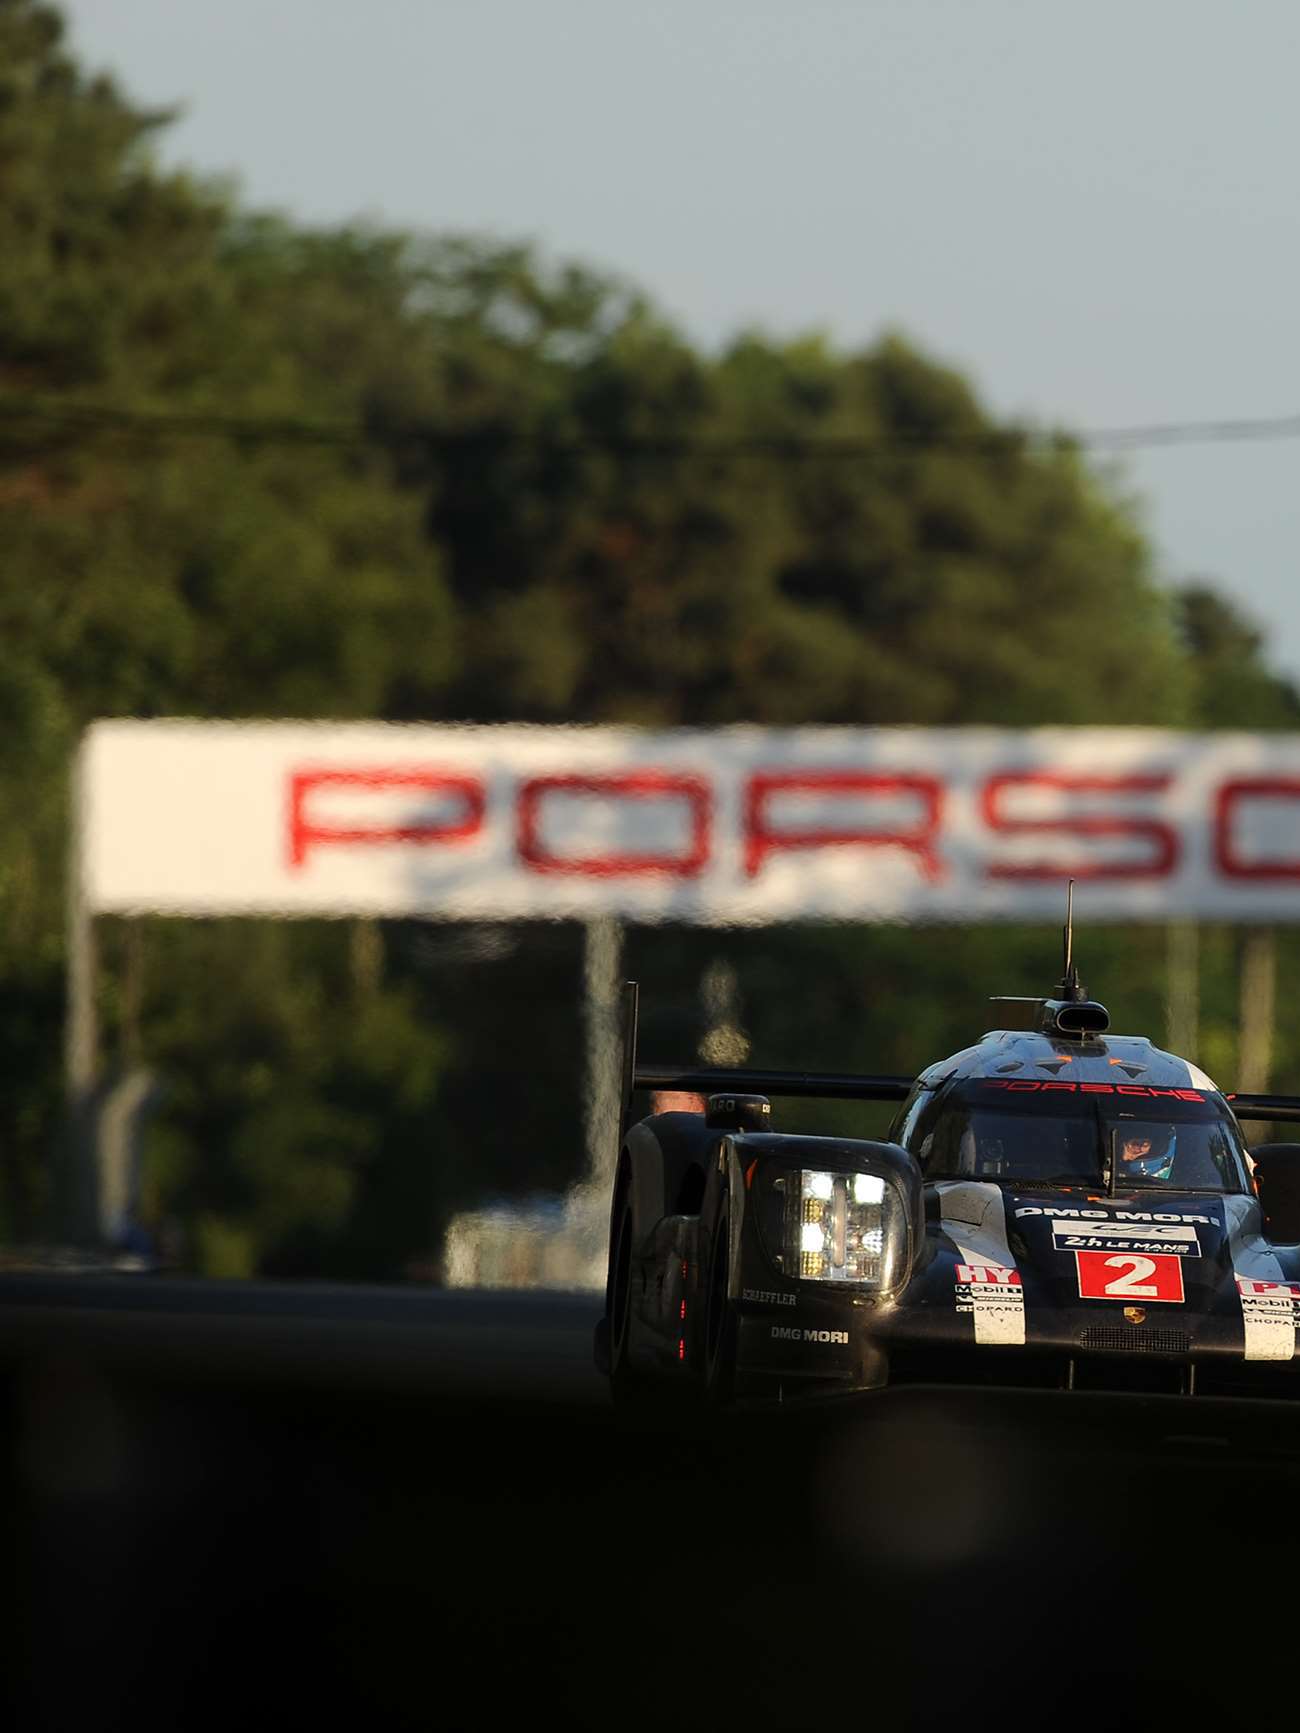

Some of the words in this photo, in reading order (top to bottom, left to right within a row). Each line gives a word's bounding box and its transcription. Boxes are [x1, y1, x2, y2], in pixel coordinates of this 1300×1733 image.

[984, 1079, 1205, 1103] PORSCHE
[1014, 1206, 1109, 1220] DMG
[1115, 1210, 1220, 1227] MORI
[1106, 1241, 1130, 1249] LE
[1132, 1242, 1190, 1252] MANS
[958, 1265, 1015, 1283] HY
[1103, 1255, 1158, 1297] 2
[956, 1285, 1004, 1294] Mobil
[1241, 1298, 1291, 1308] Mobil
[771, 1326, 801, 1340] DMG
[803, 1329, 849, 1344] MORI
